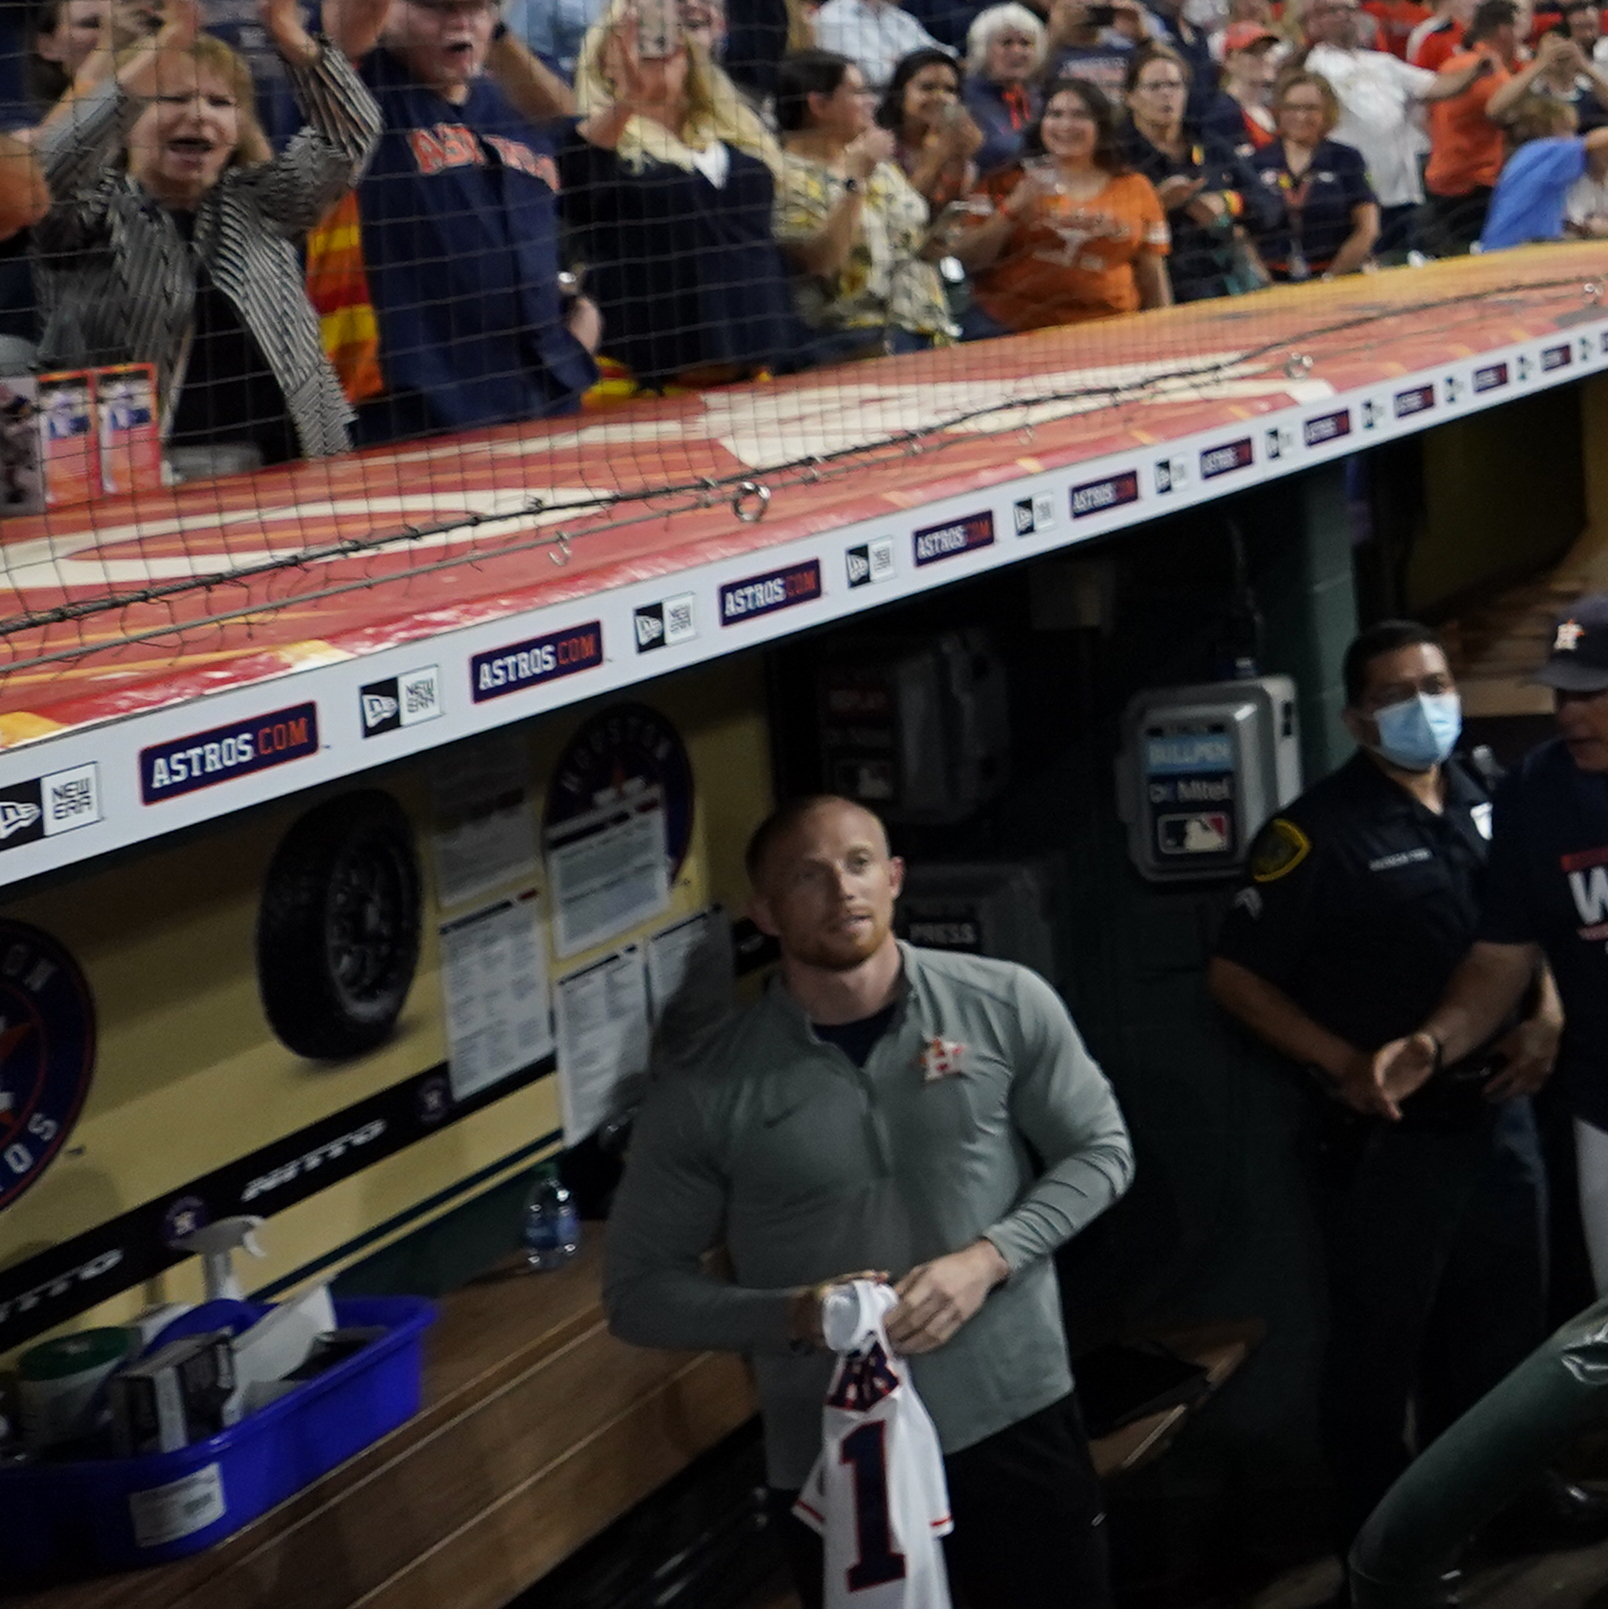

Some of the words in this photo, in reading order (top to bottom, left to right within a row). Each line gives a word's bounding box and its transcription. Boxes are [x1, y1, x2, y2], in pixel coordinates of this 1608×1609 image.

[479, 633, 598, 691] ASTROS.COM
[152, 717, 308, 789] ASTROS.COM
[53, 776, 92, 801] NEW
[53, 795, 93, 820] ERA
[840, 1419, 906, 1593] 1
